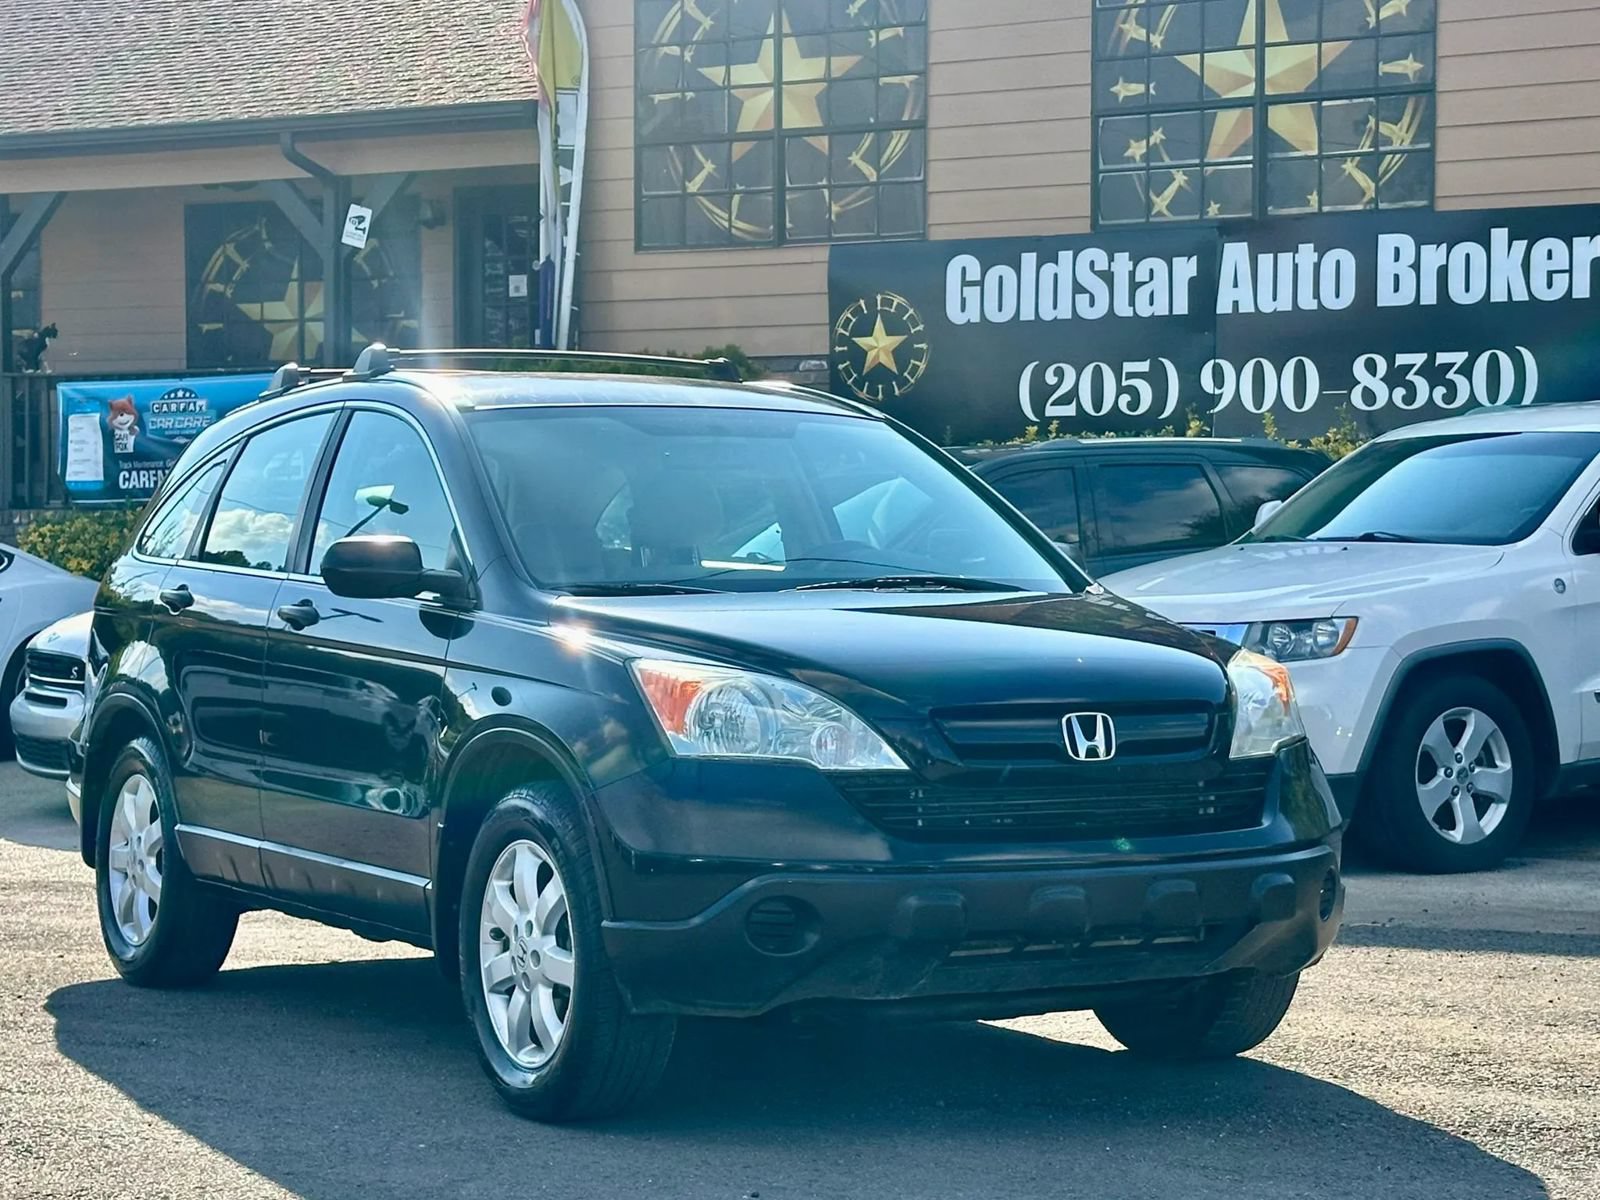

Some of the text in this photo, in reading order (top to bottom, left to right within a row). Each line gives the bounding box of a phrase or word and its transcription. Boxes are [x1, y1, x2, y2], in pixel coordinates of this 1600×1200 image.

[945, 227, 1600, 325] GoldStar Auto Broker
[151, 400, 207, 413] CARFAX
[1018, 345, 1539, 422] (205) 900-8330)
